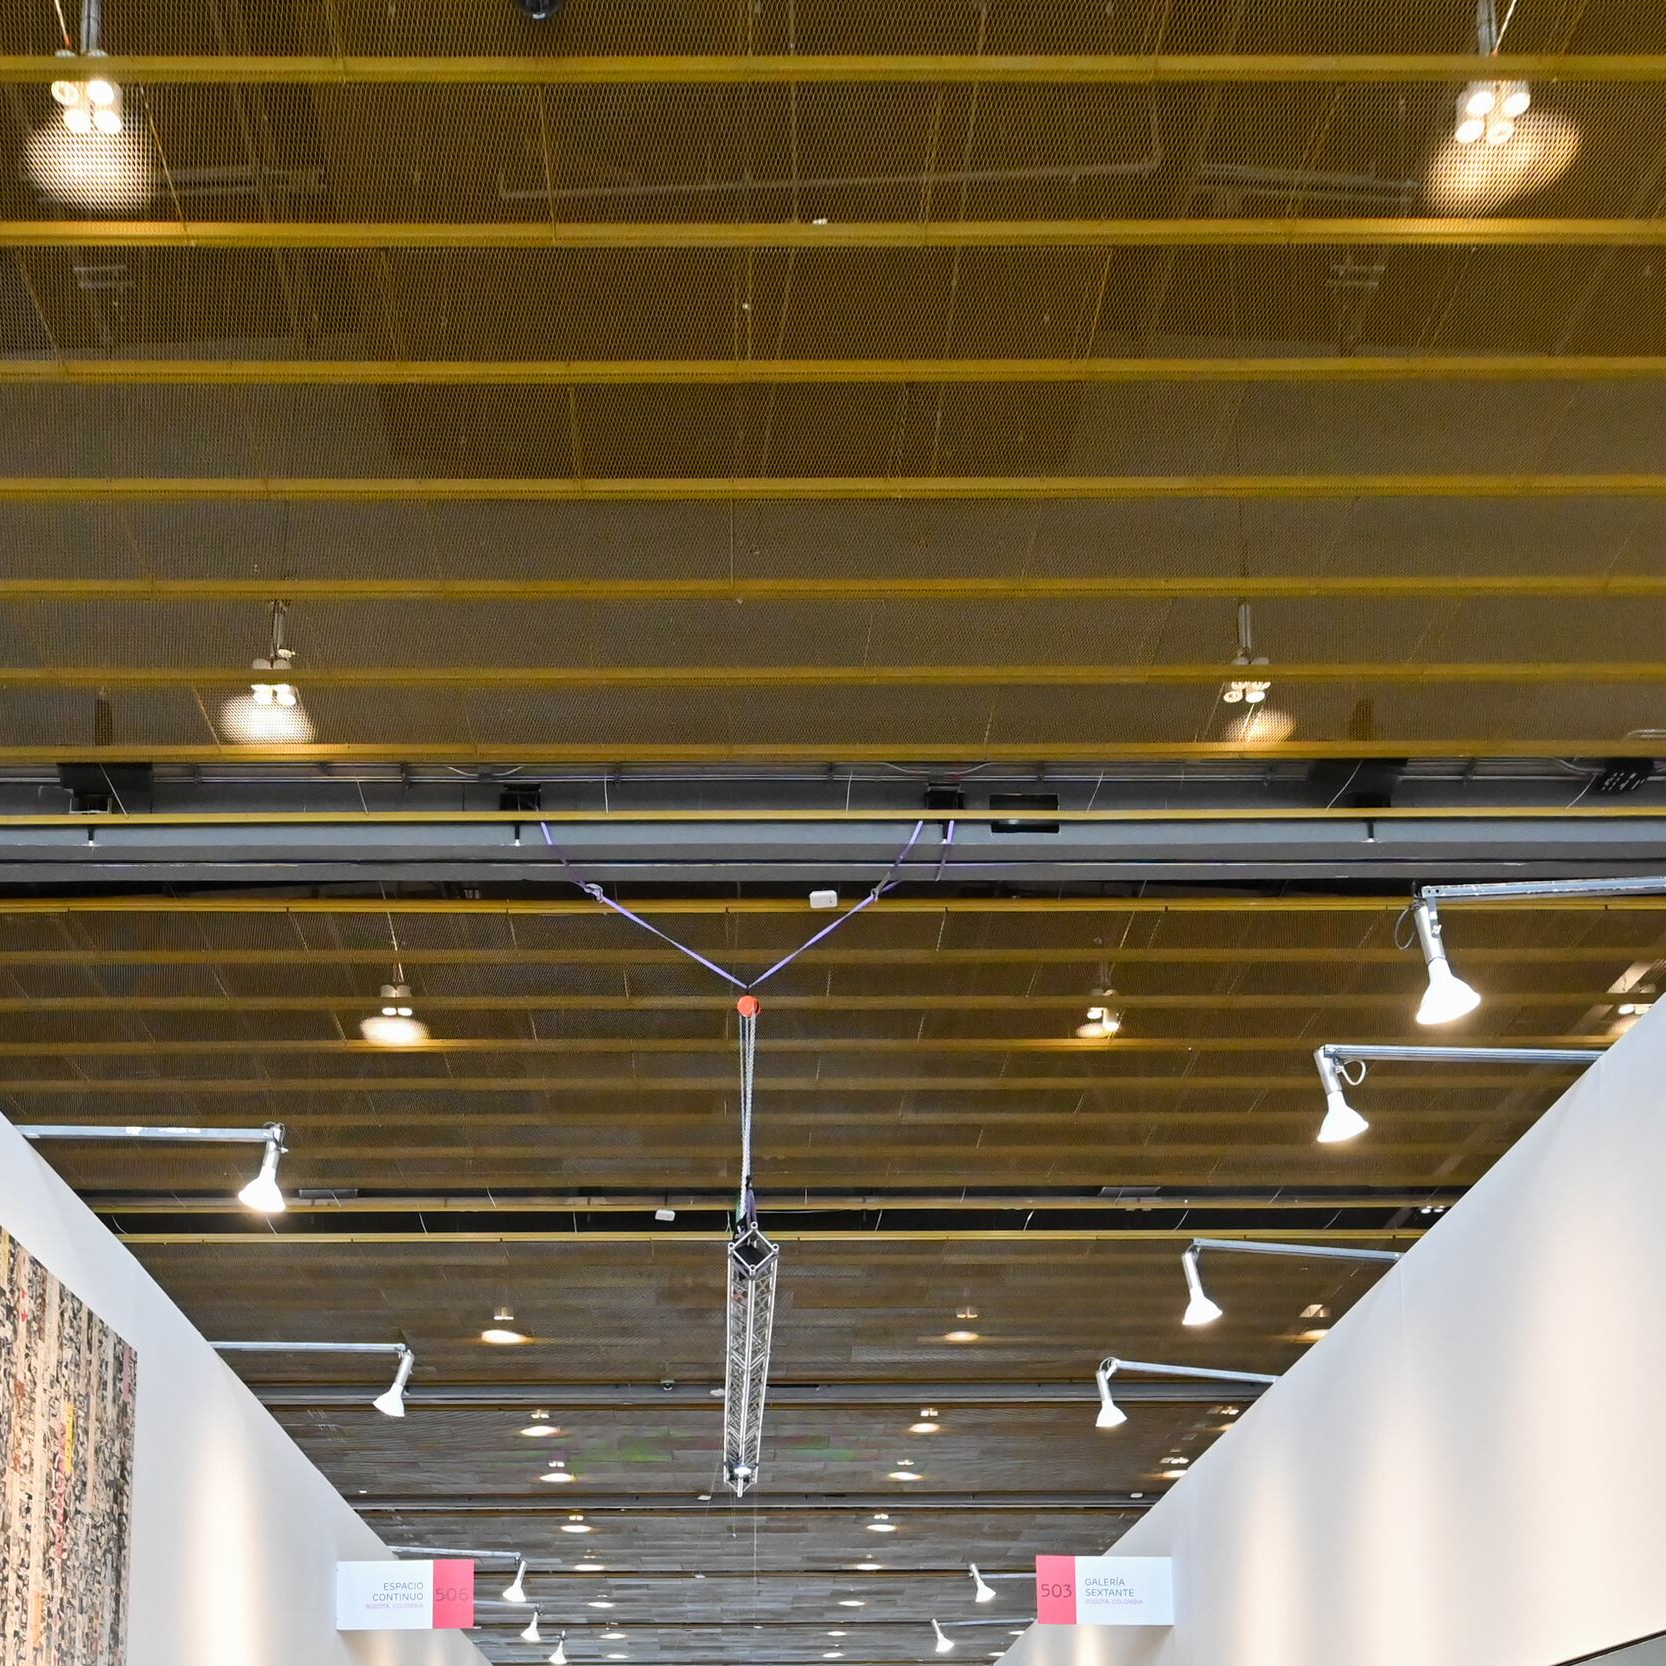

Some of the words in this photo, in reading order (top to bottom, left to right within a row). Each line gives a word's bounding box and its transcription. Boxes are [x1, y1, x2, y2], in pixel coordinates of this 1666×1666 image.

[383, 1581, 424, 1591] ESPACIO
[1084, 1576, 1126, 1587] GALERÍA
[435, 1586, 470, 1602] 506
[1041, 1583, 1072, 1598] 503
[1084, 1588, 1134, 1597] SEXTANTE
[372, 1592, 424, 1601] CONTINUO
